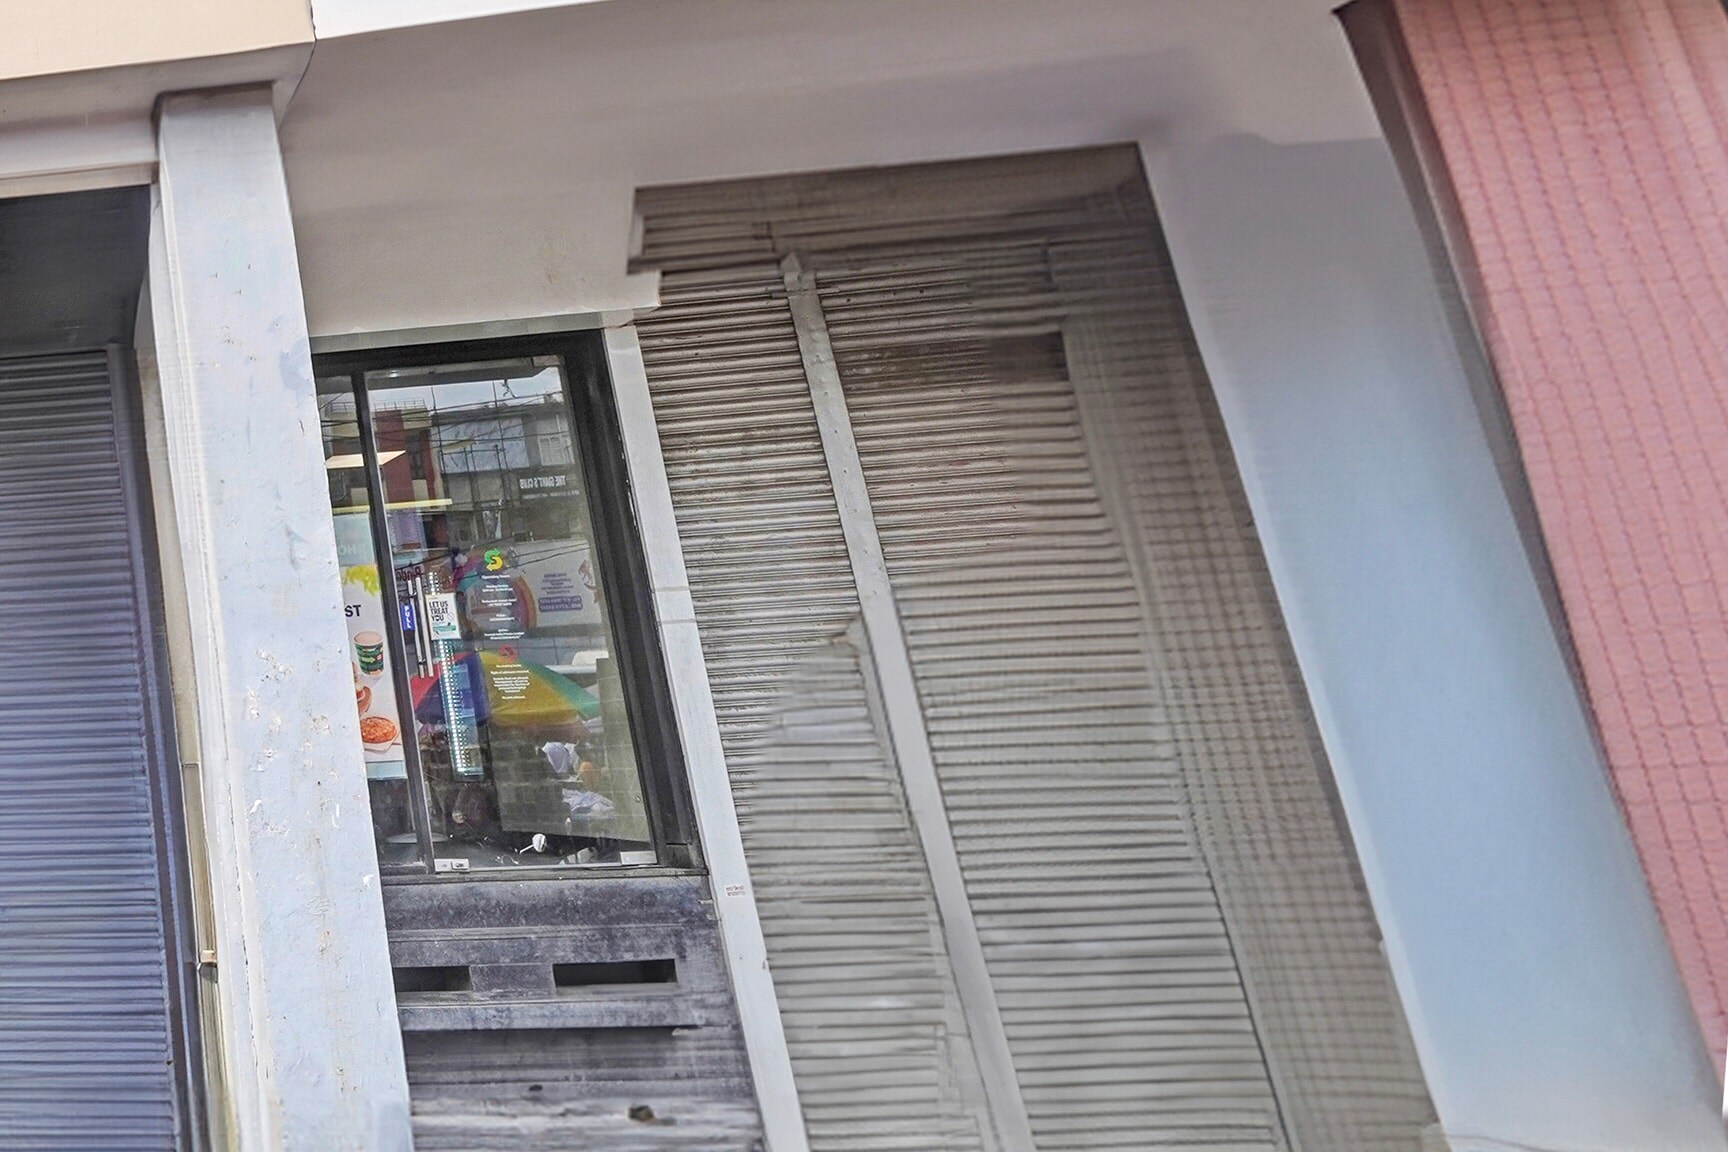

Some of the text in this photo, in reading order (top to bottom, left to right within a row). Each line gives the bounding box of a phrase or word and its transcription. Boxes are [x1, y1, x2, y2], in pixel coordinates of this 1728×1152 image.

[429, 600, 449, 609] LET US
[430, 607, 449, 615] TREAT
[431, 614, 445, 622] YOU
